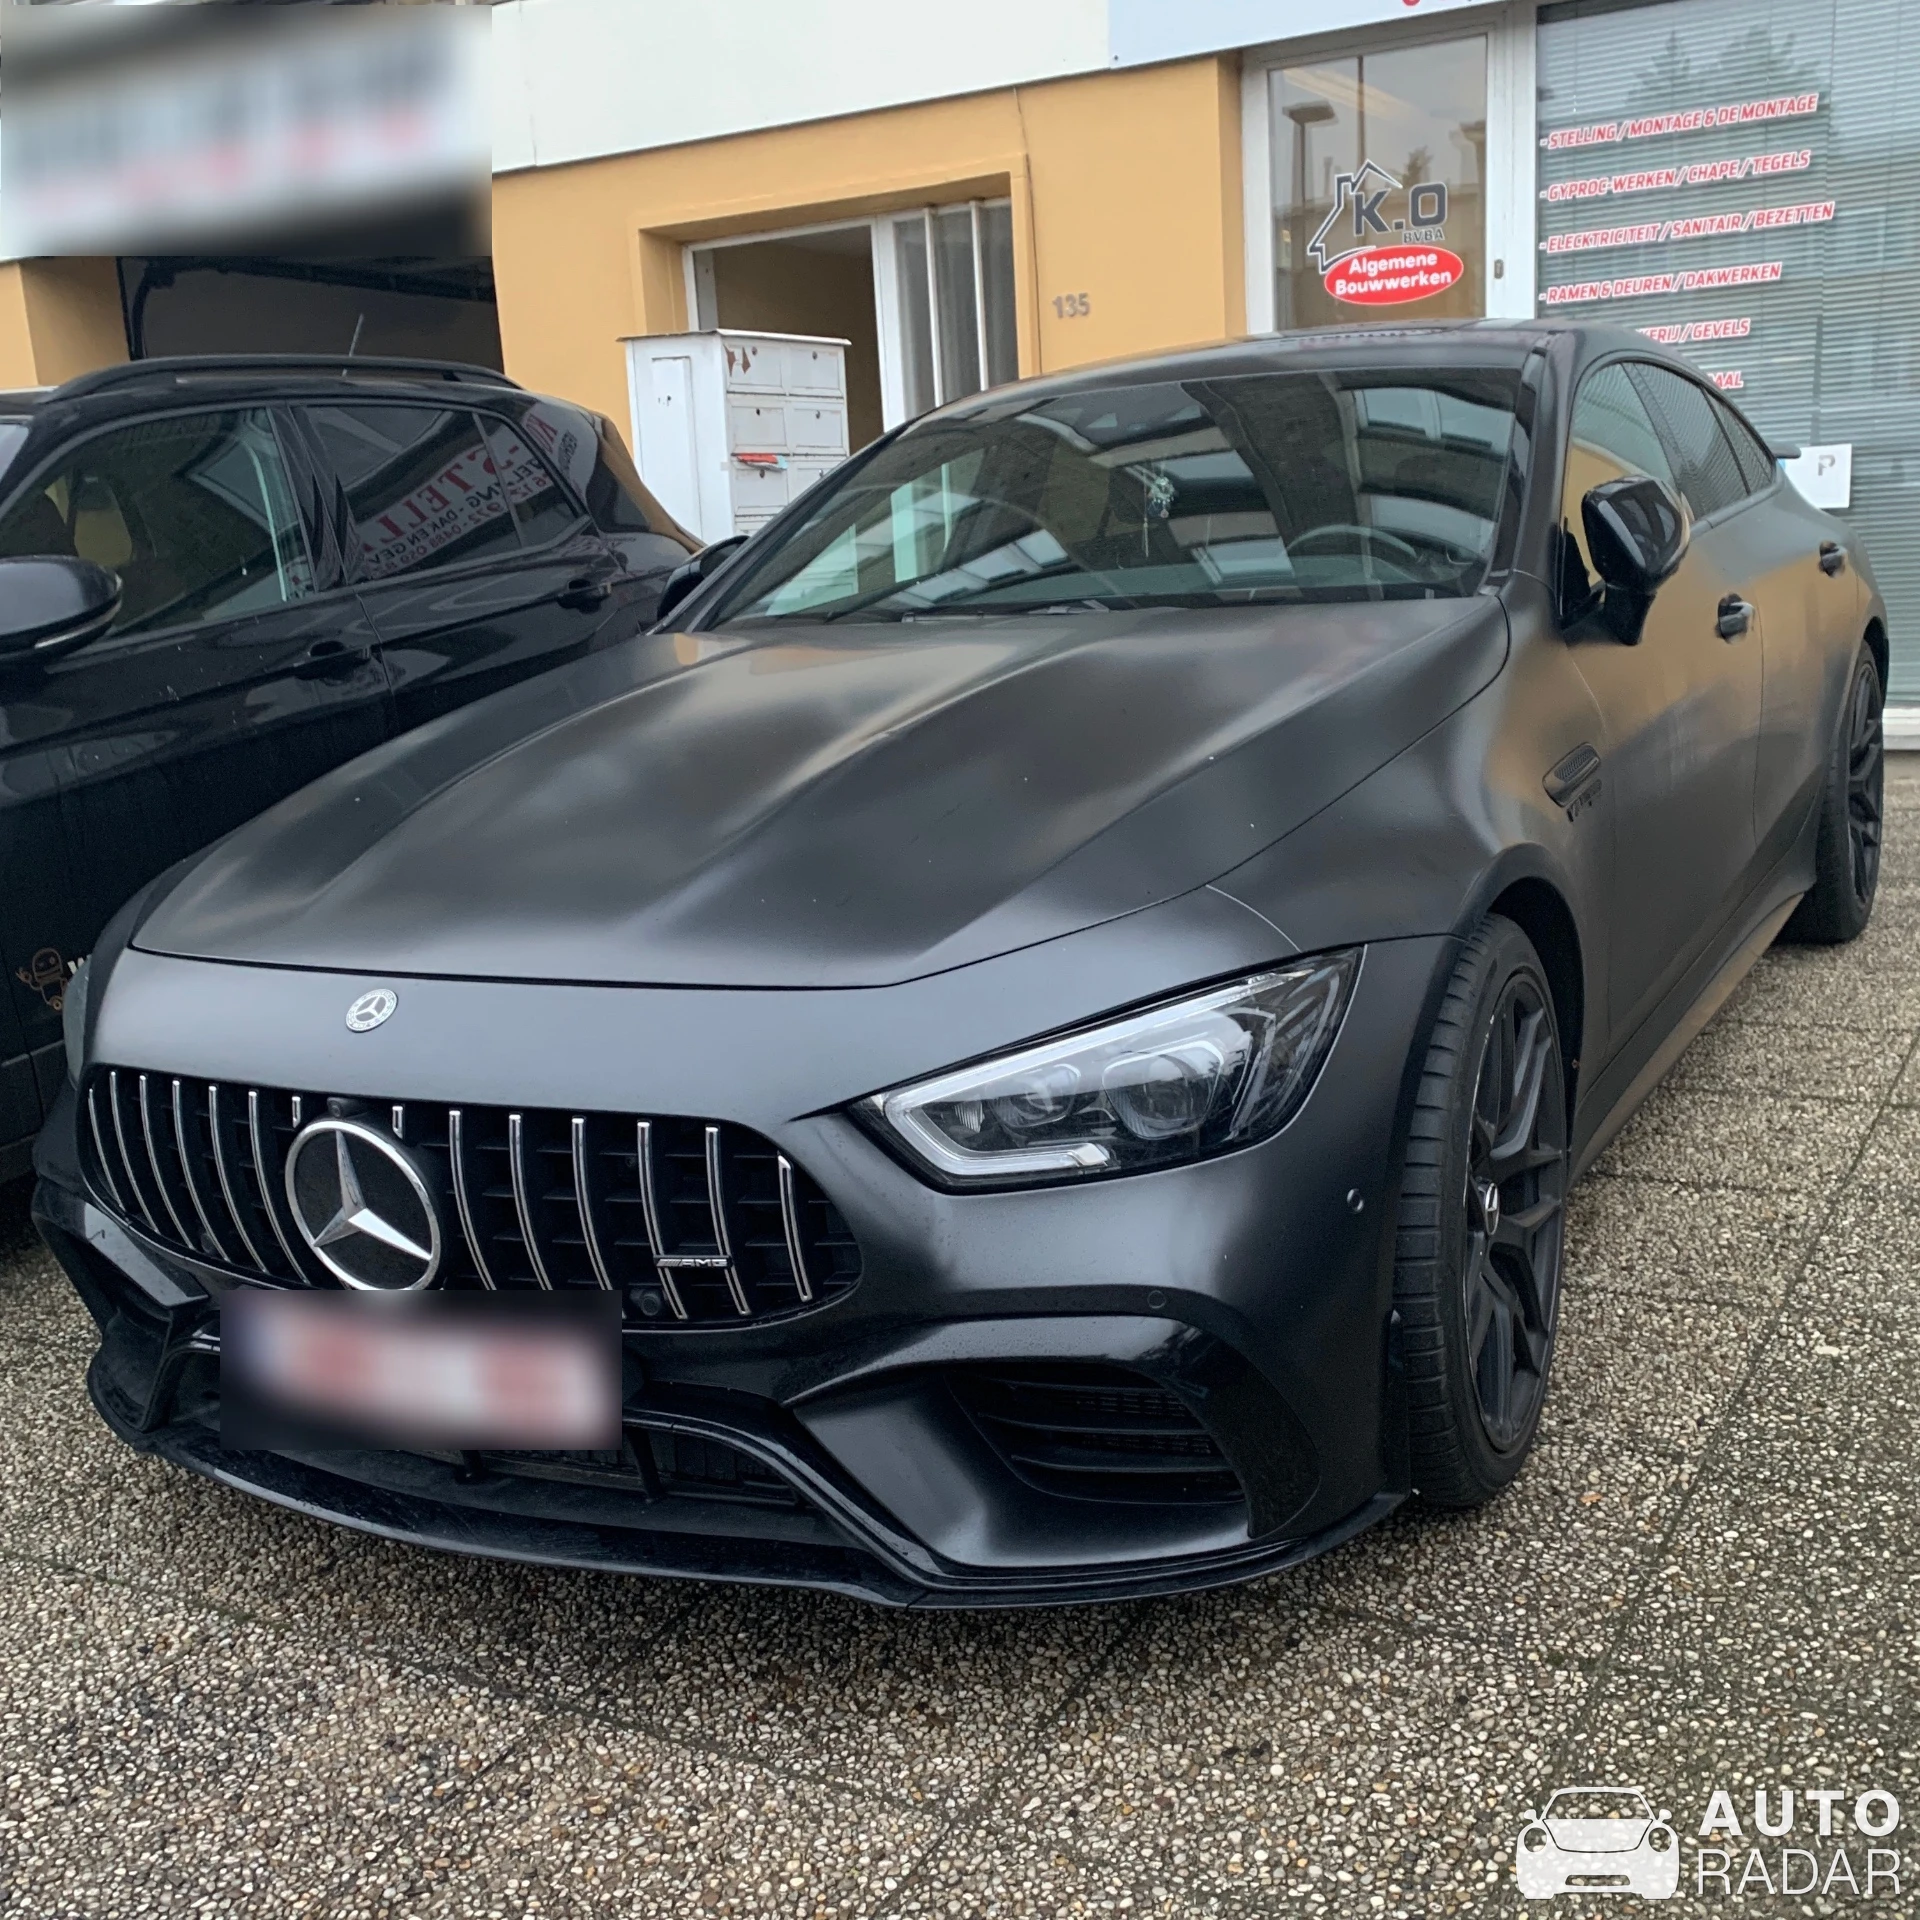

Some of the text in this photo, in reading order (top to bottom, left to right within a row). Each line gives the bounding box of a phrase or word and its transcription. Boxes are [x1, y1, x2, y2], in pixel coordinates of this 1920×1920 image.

[1703, 109, 1715, 128] &
[1740, 94, 1819, 121] MONTAGE
[1402, 227, 1445, 244] BVBA
[1349, 253, 1437, 277] Algemene
[1335, 271, 1452, 295] Bouwwerken
[1600, 281, 1613, 298] &
[1052, 292, 1090, 319] 135
[1692, 317, 1751, 340] GEVELS
